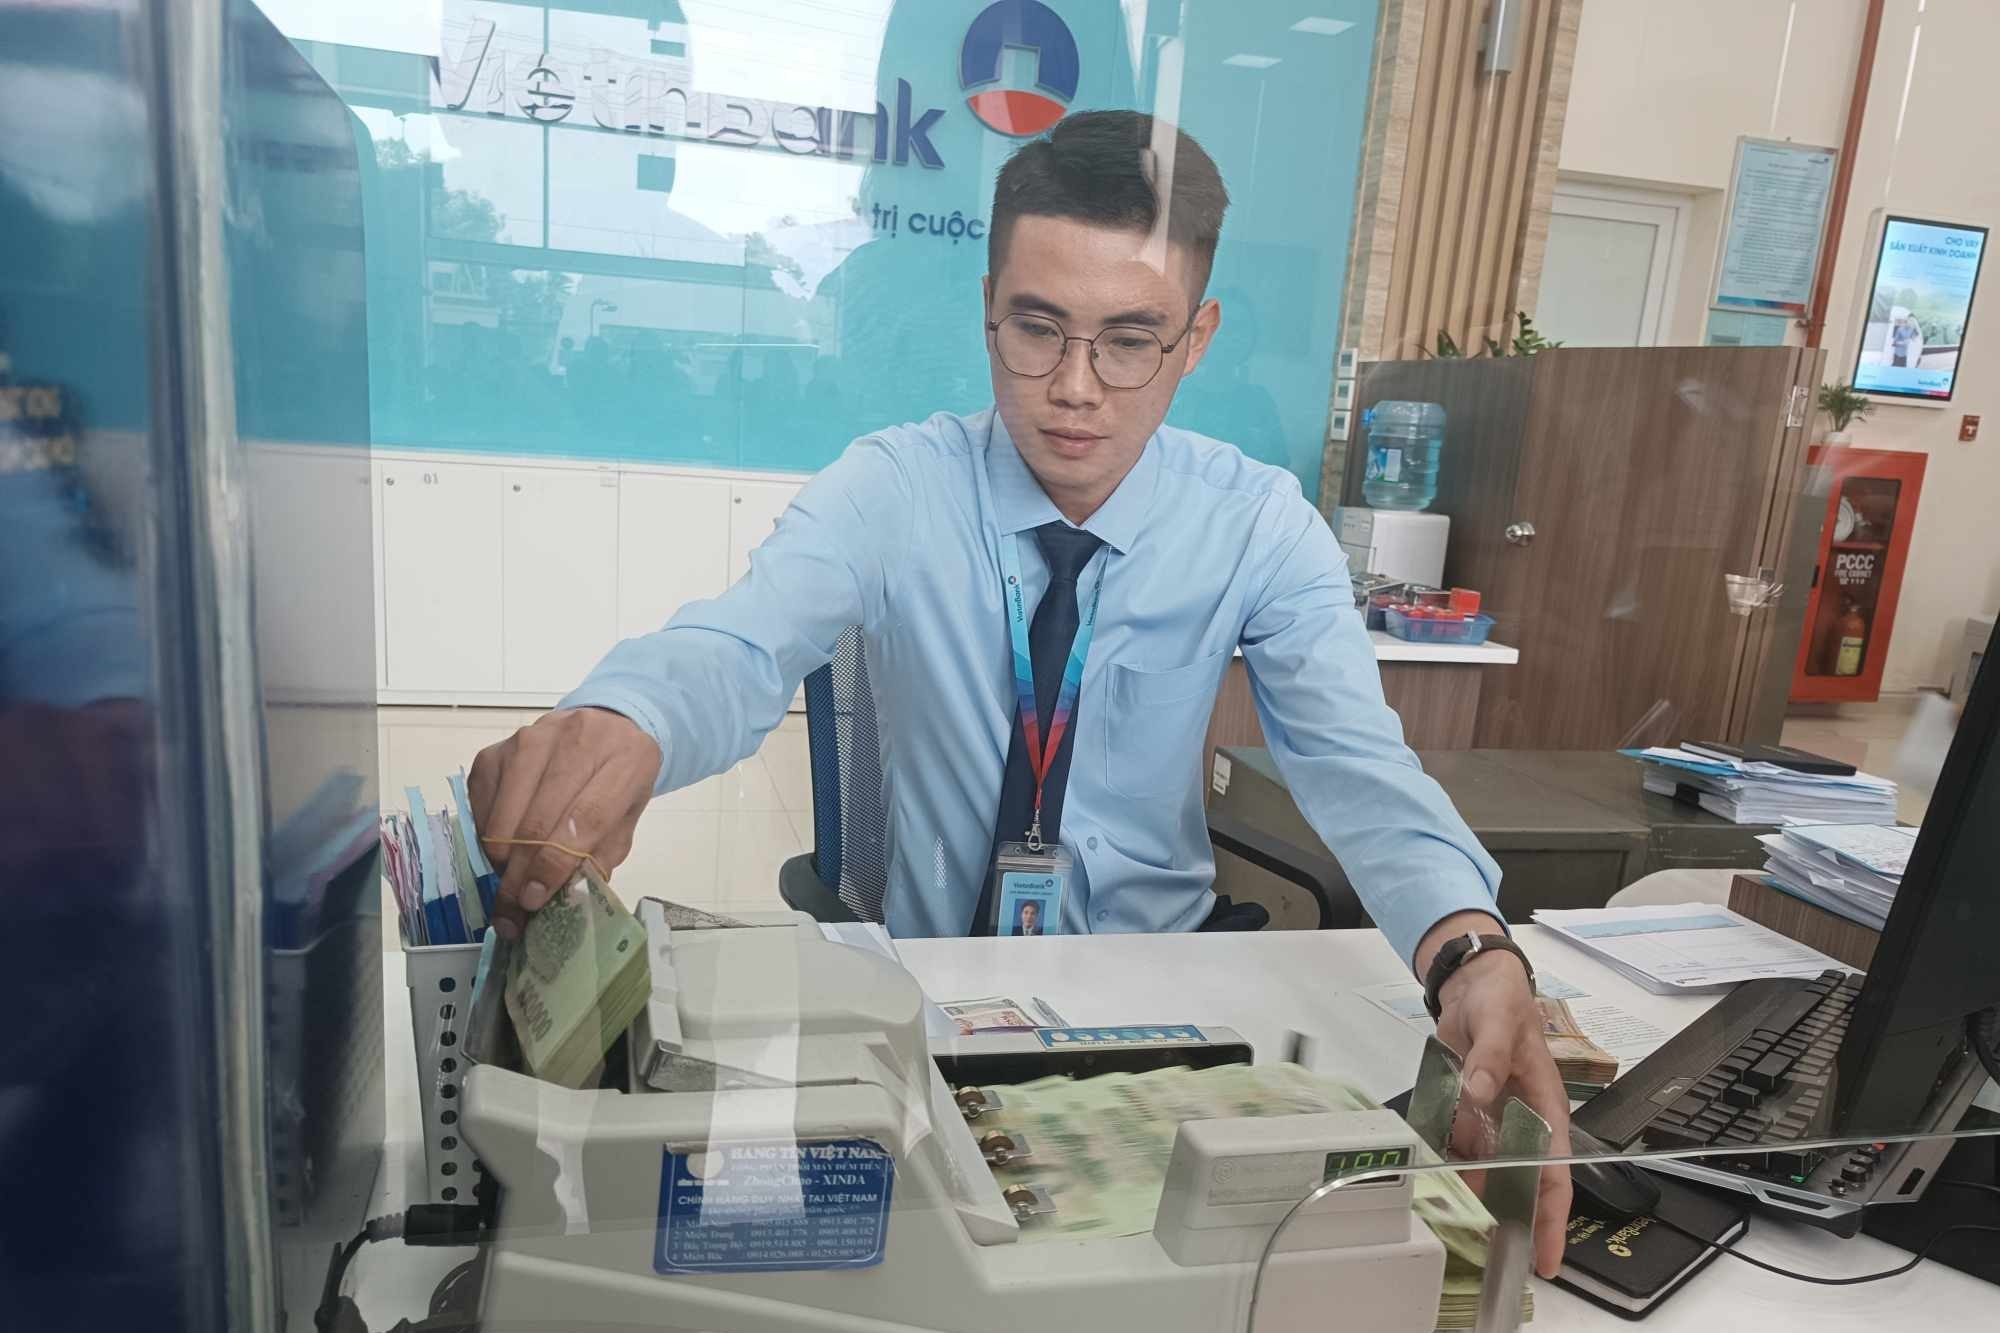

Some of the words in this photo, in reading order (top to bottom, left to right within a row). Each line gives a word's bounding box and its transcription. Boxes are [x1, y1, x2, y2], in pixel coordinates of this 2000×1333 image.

[873, 203, 898, 239] trị
[908, 211, 985, 245] cuộc
[1836, 554, 1875, 570] PCCC
[809, 1144, 847, 1160] VIỆT
[823, 1174, 866, 1185] XINDA
[827, 1192, 851, 1204] VIỆT
[852, 1193, 878, 1203] NAM
